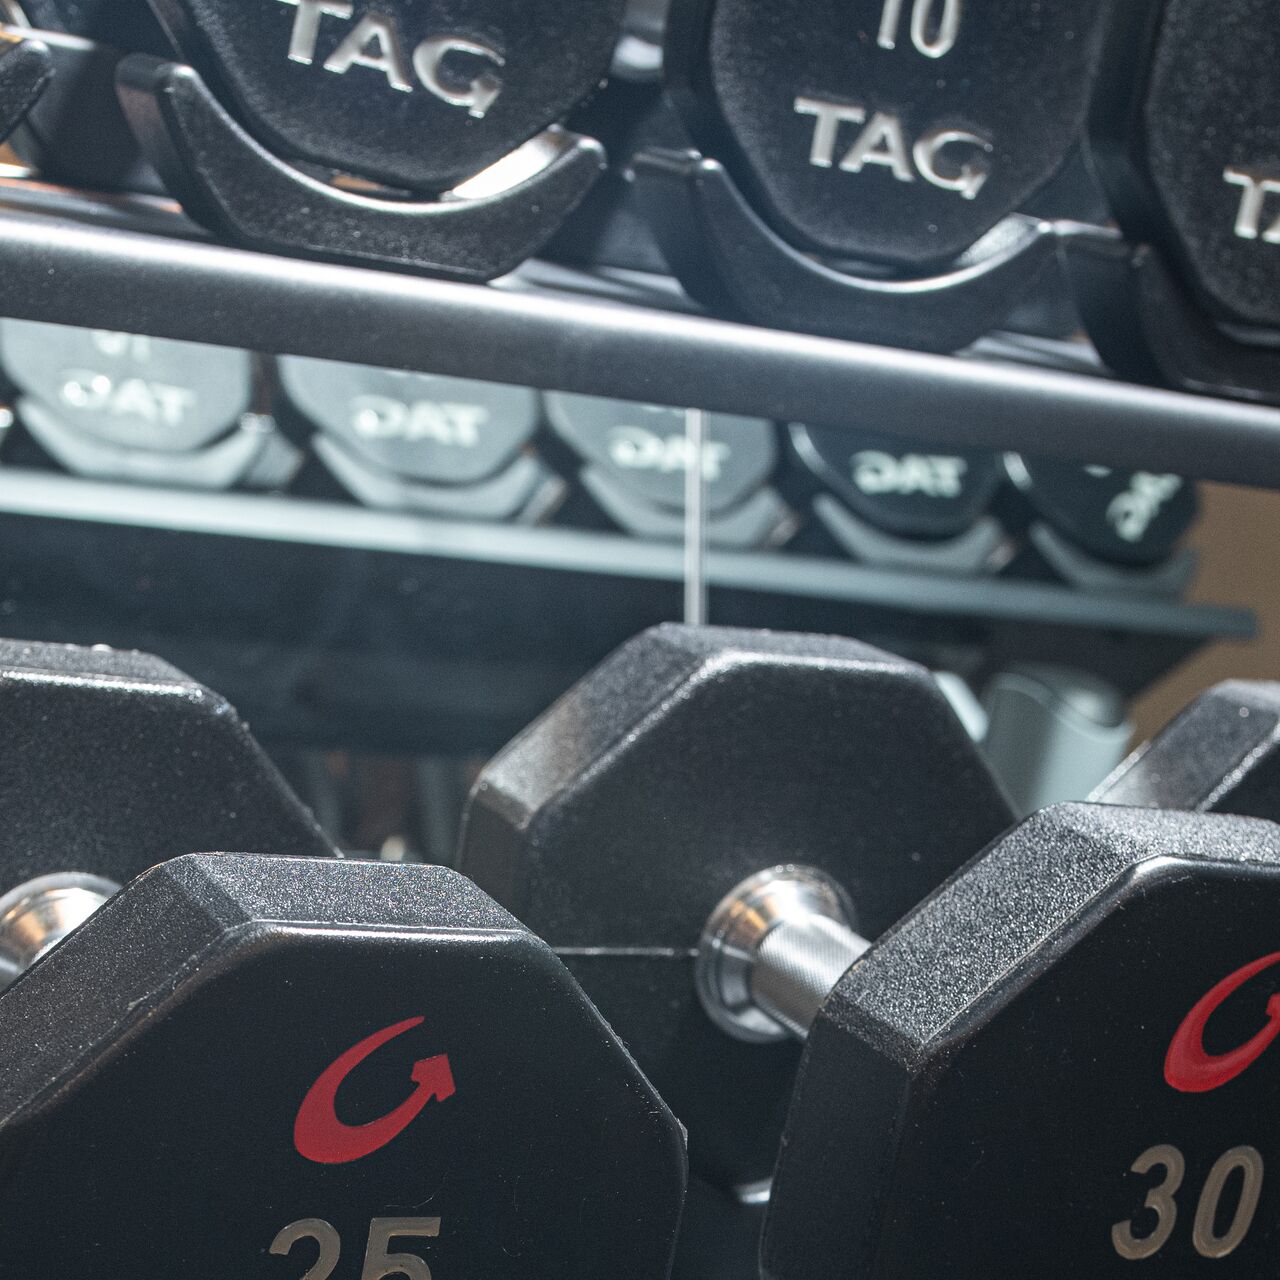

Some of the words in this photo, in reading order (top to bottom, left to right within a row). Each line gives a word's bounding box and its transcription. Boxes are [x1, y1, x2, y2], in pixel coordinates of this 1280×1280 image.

[276, 0, 506, 119] TAG
[793, 95, 994, 201] TAG
[1110, 1143, 1265, 1262] 30
